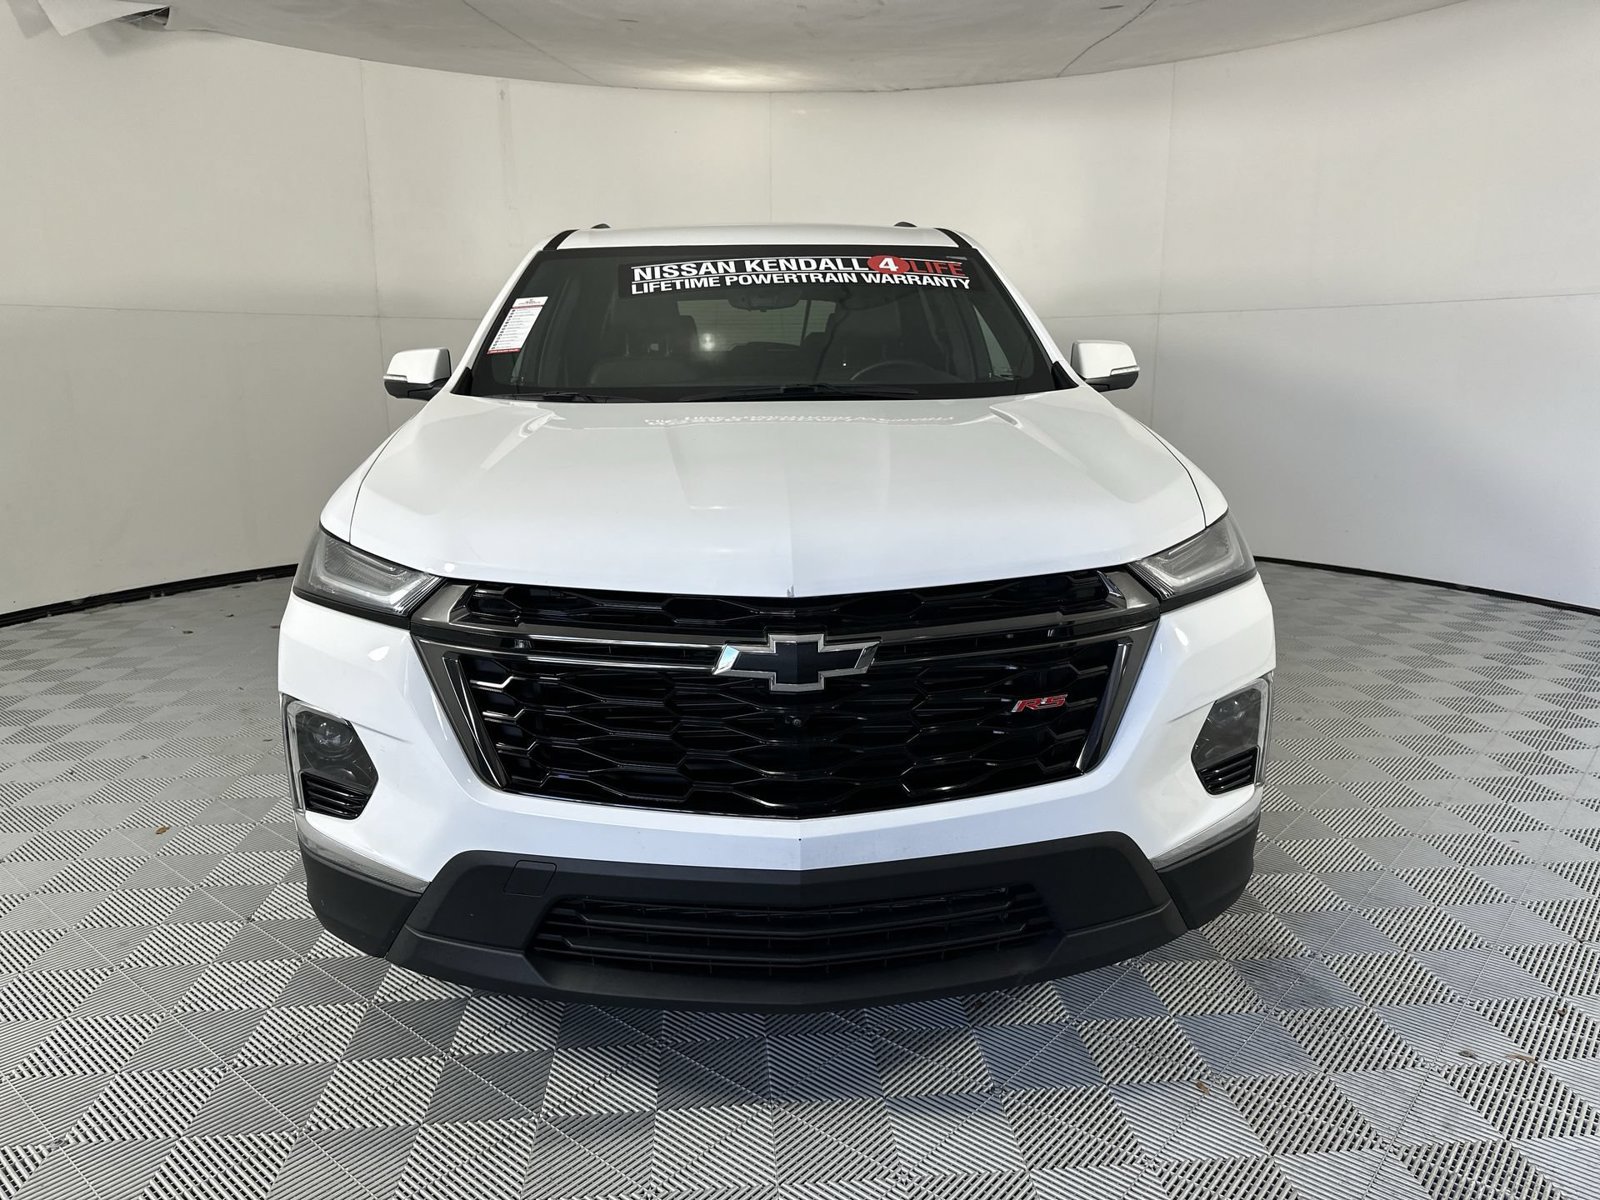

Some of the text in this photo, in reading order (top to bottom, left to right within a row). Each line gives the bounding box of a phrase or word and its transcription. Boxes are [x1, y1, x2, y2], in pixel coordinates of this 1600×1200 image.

[633, 257, 966, 281] NISSAN KENDALL 4 LIFE
[631, 272, 970, 295] LIFETIME POWERTRAIN WARRANTY
[1011, 694, 1068, 712] RS
